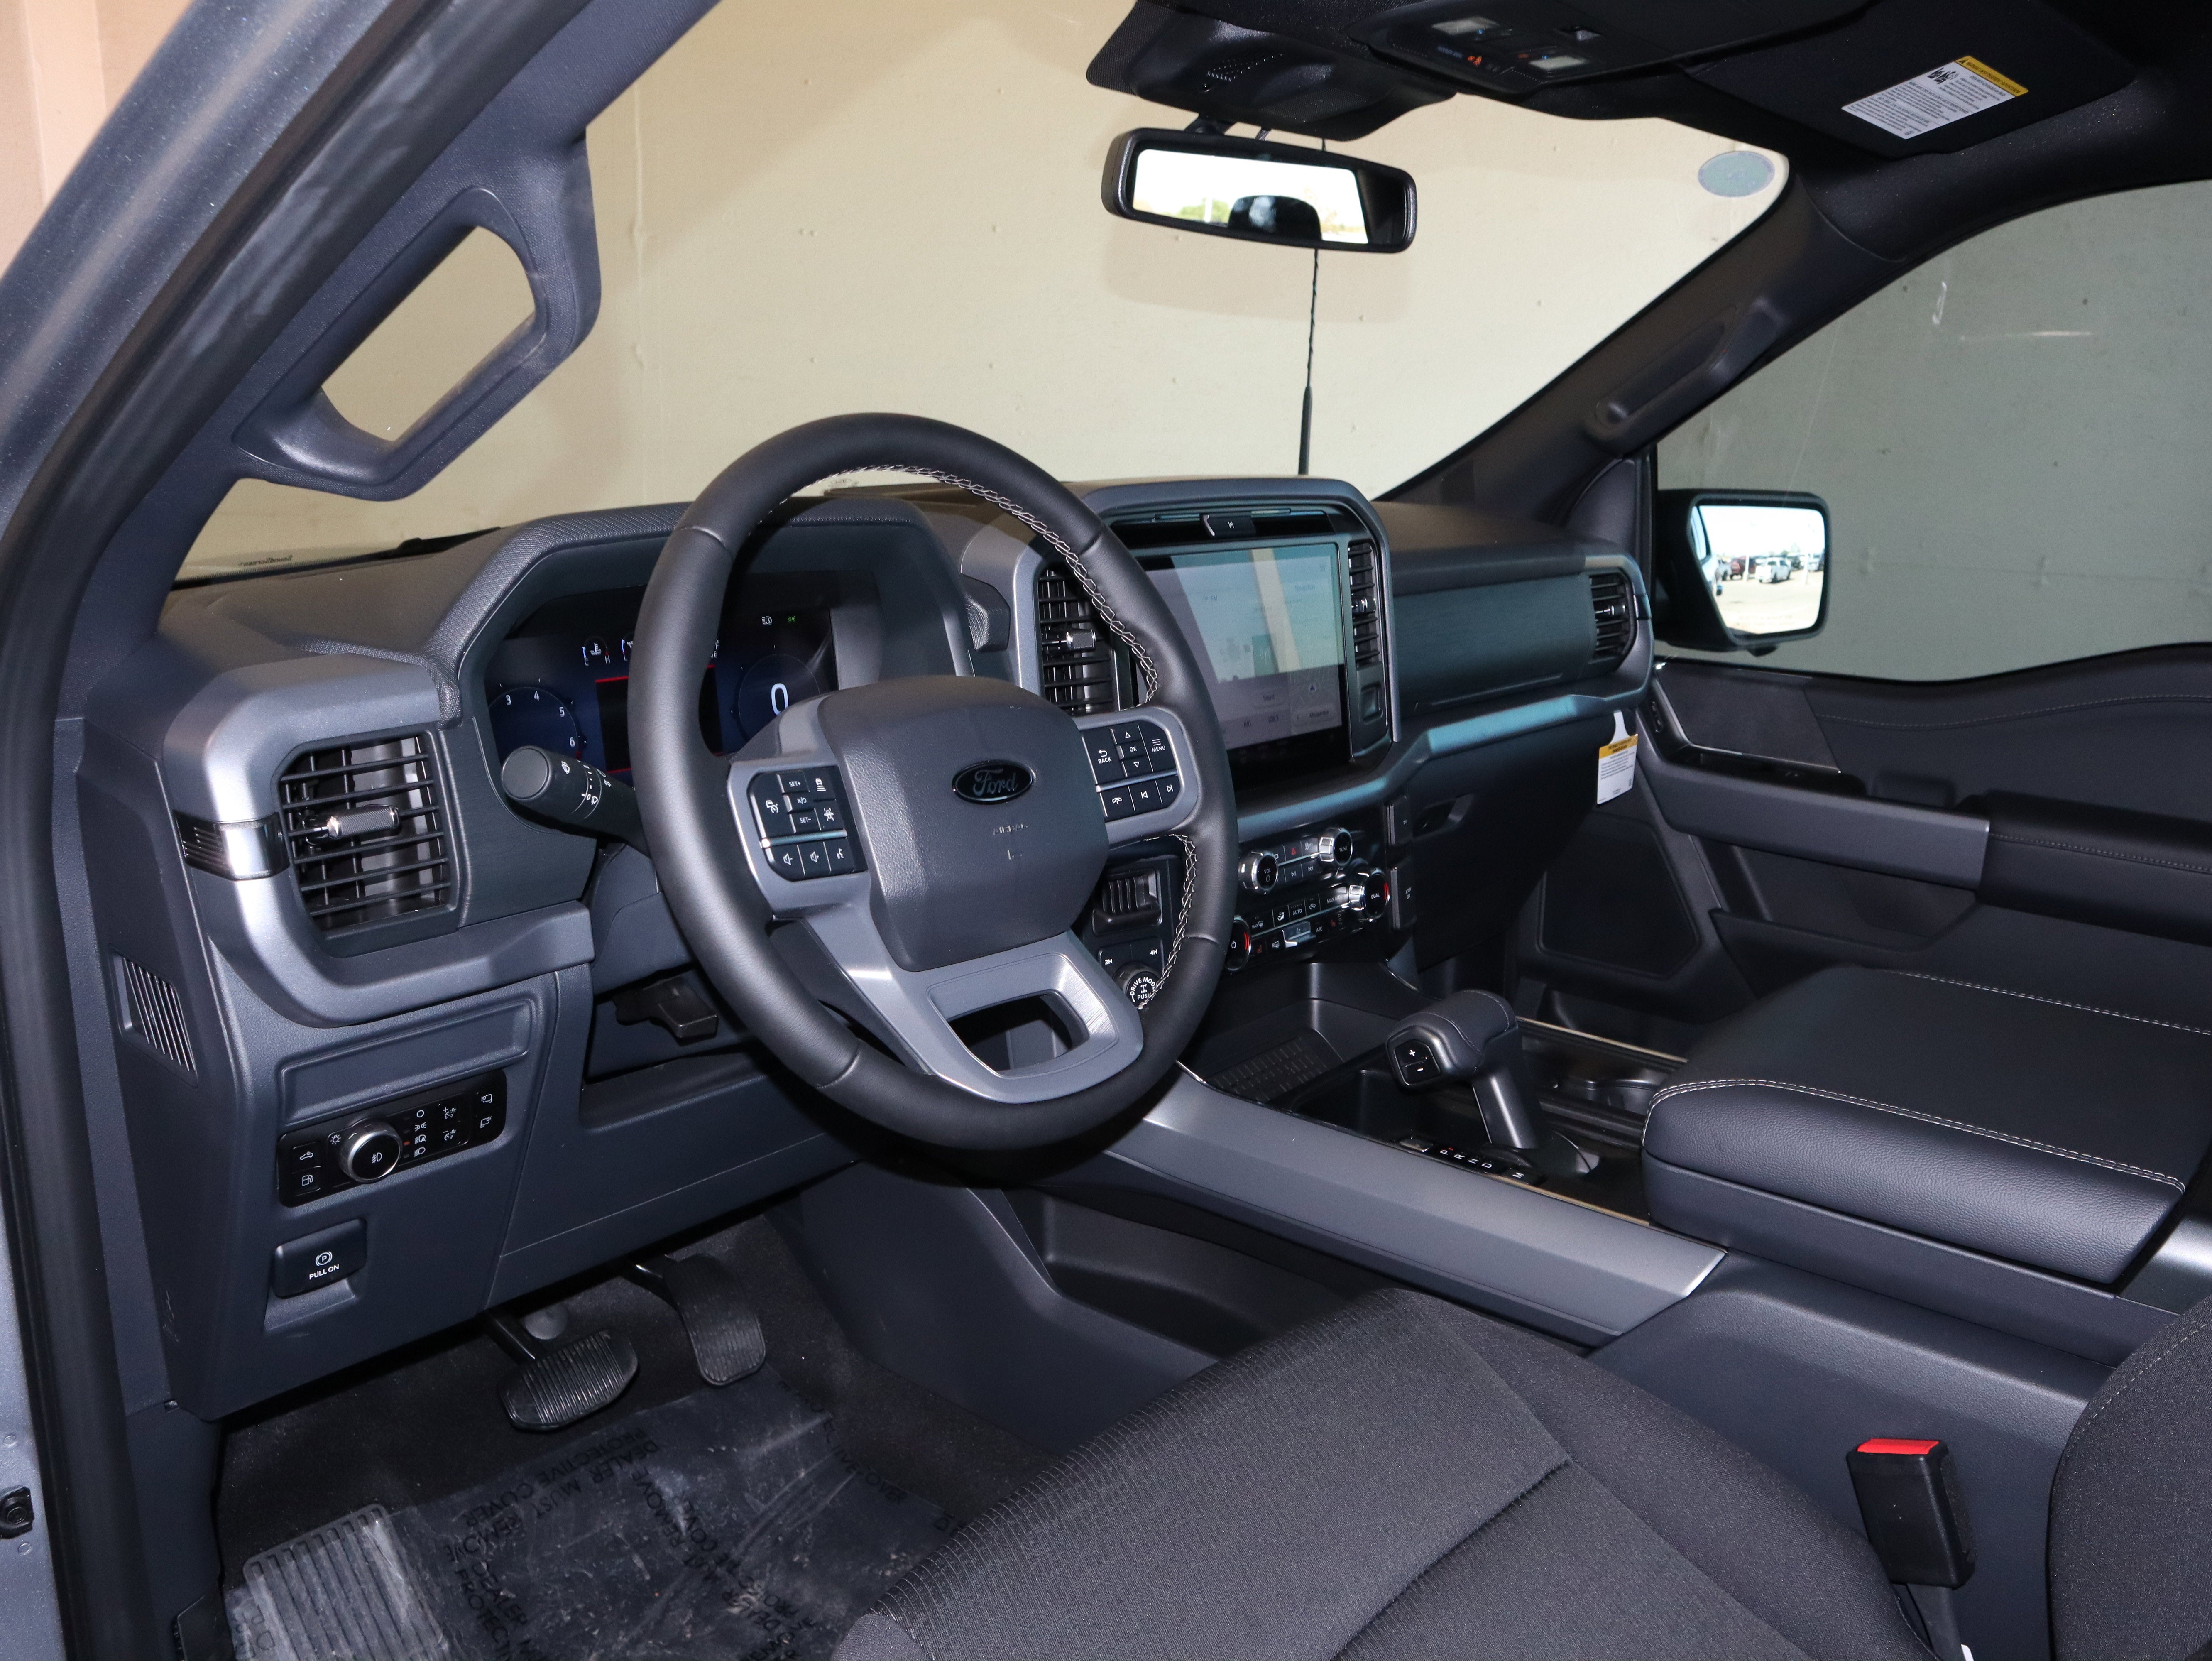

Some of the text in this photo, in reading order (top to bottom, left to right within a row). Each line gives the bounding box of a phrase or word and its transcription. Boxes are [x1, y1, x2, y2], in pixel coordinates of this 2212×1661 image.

[605, 655, 610, 664] H
[505, 695, 511, 706] 3
[534, 690, 540, 701] 4
[771, 683, 789, 716] 0
[559, 707, 565, 717] 5
[570, 737, 576, 747] 6
[972, 768, 1018, 796] Ford
[1130, 977, 1143, 996] DRIVE
[309, 1264, 339, 1280] PULL ON
[535, 1426, 648, 1489] PROTECTIVE
[589, 1439, 660, 1484] DEALER
[531, 1478, 581, 1519] MUST
